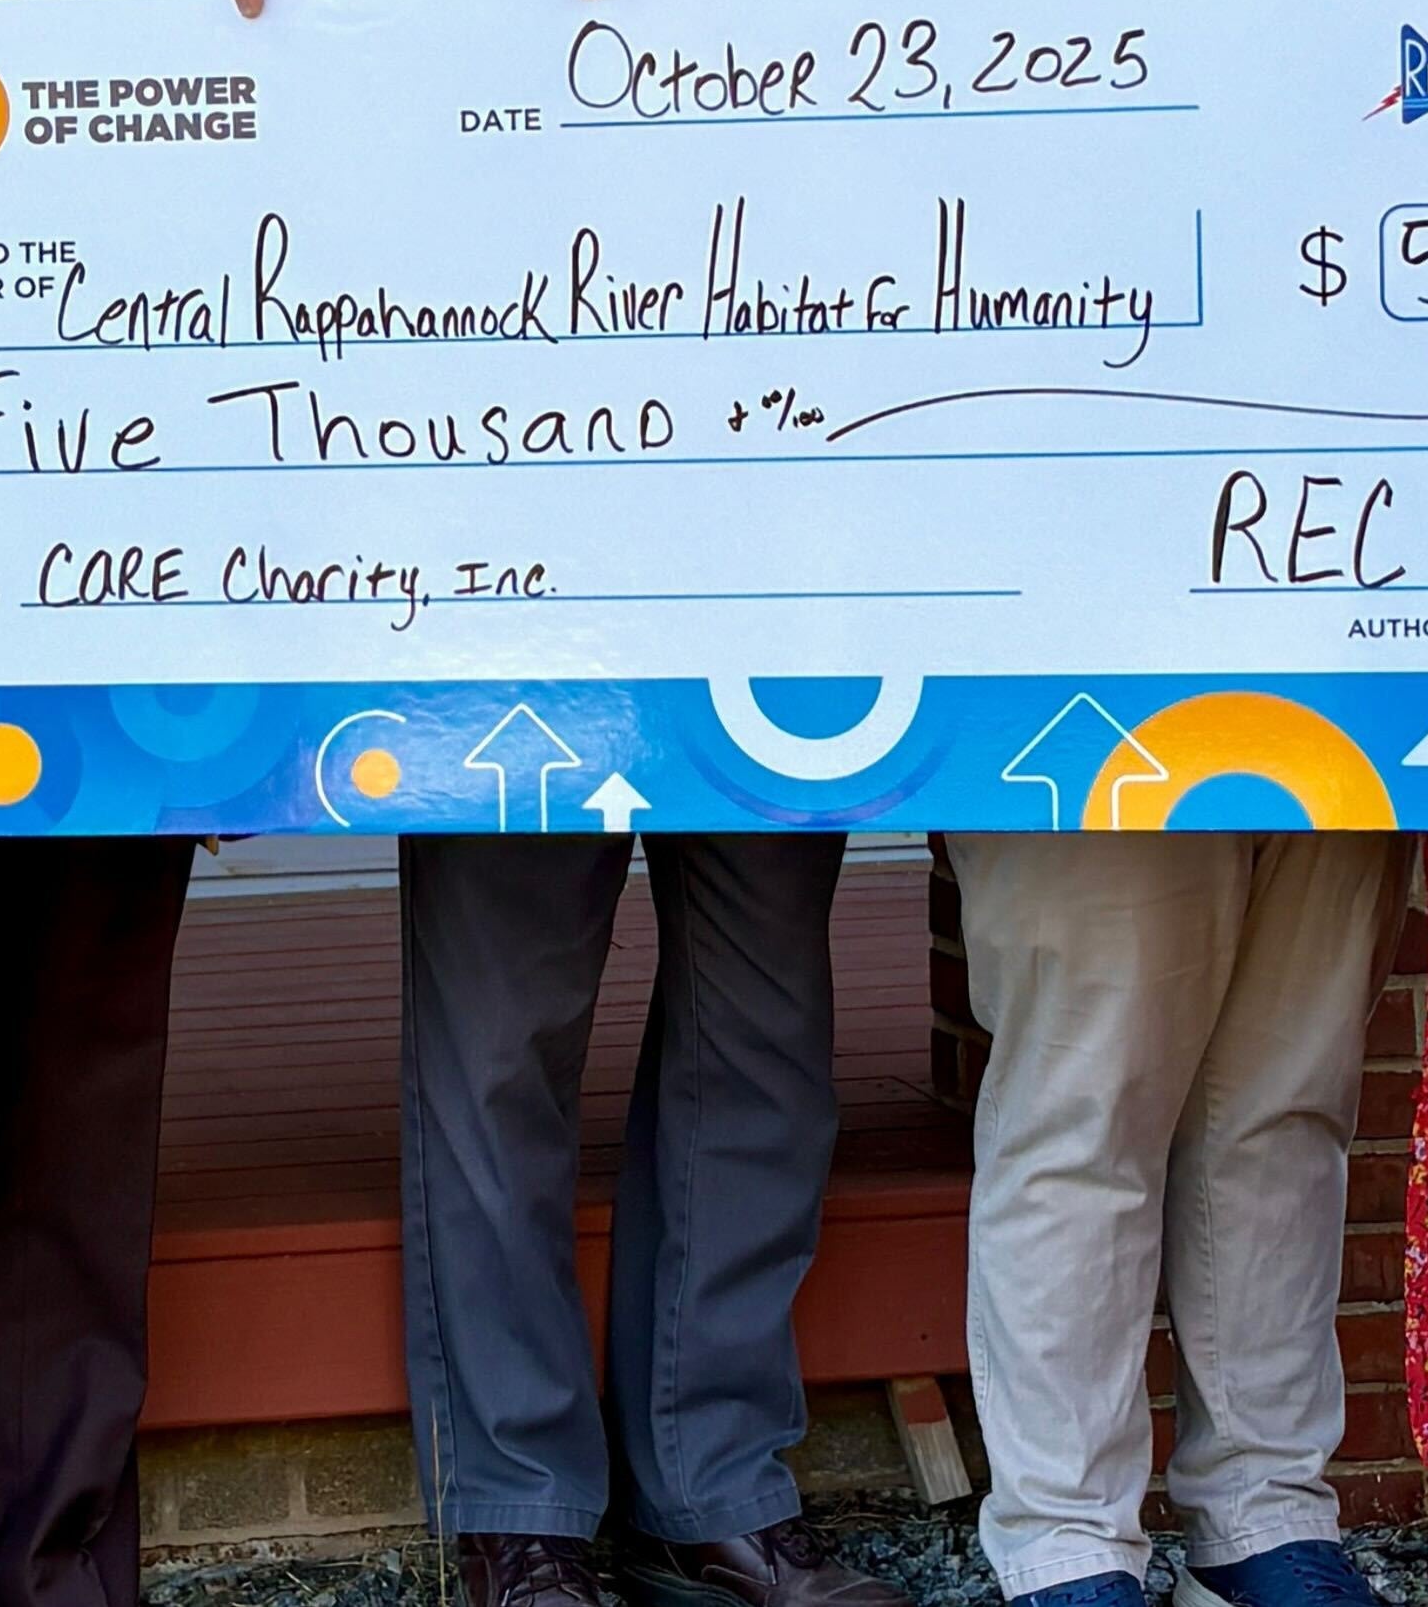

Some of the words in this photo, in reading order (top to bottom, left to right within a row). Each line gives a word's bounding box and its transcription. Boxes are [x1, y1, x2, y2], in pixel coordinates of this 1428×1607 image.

[972, 28, 1148, 92] 2025
[22, 81, 99, 109] THE
[110, 76, 257, 107] POWER
[24, 116, 78, 145] OF
[89, 111, 257, 144] CHANGE
[460, 108, 542, 135] DATE
[19, 241, 76, 264] THE
[1299, 225, 1347, 307] $
[14, 275, 56, 299] OF
[58, 263, 228, 351] Central
[256, 212, 558, 361] Rappahannock
[571, 228, 683, 336] River
[705, 197, 854, 340] Habitat
[934, 197, 1152, 368] Humanity
[1210, 470, 1406, 590] REC
[455, 561, 557, 598] Inc.
